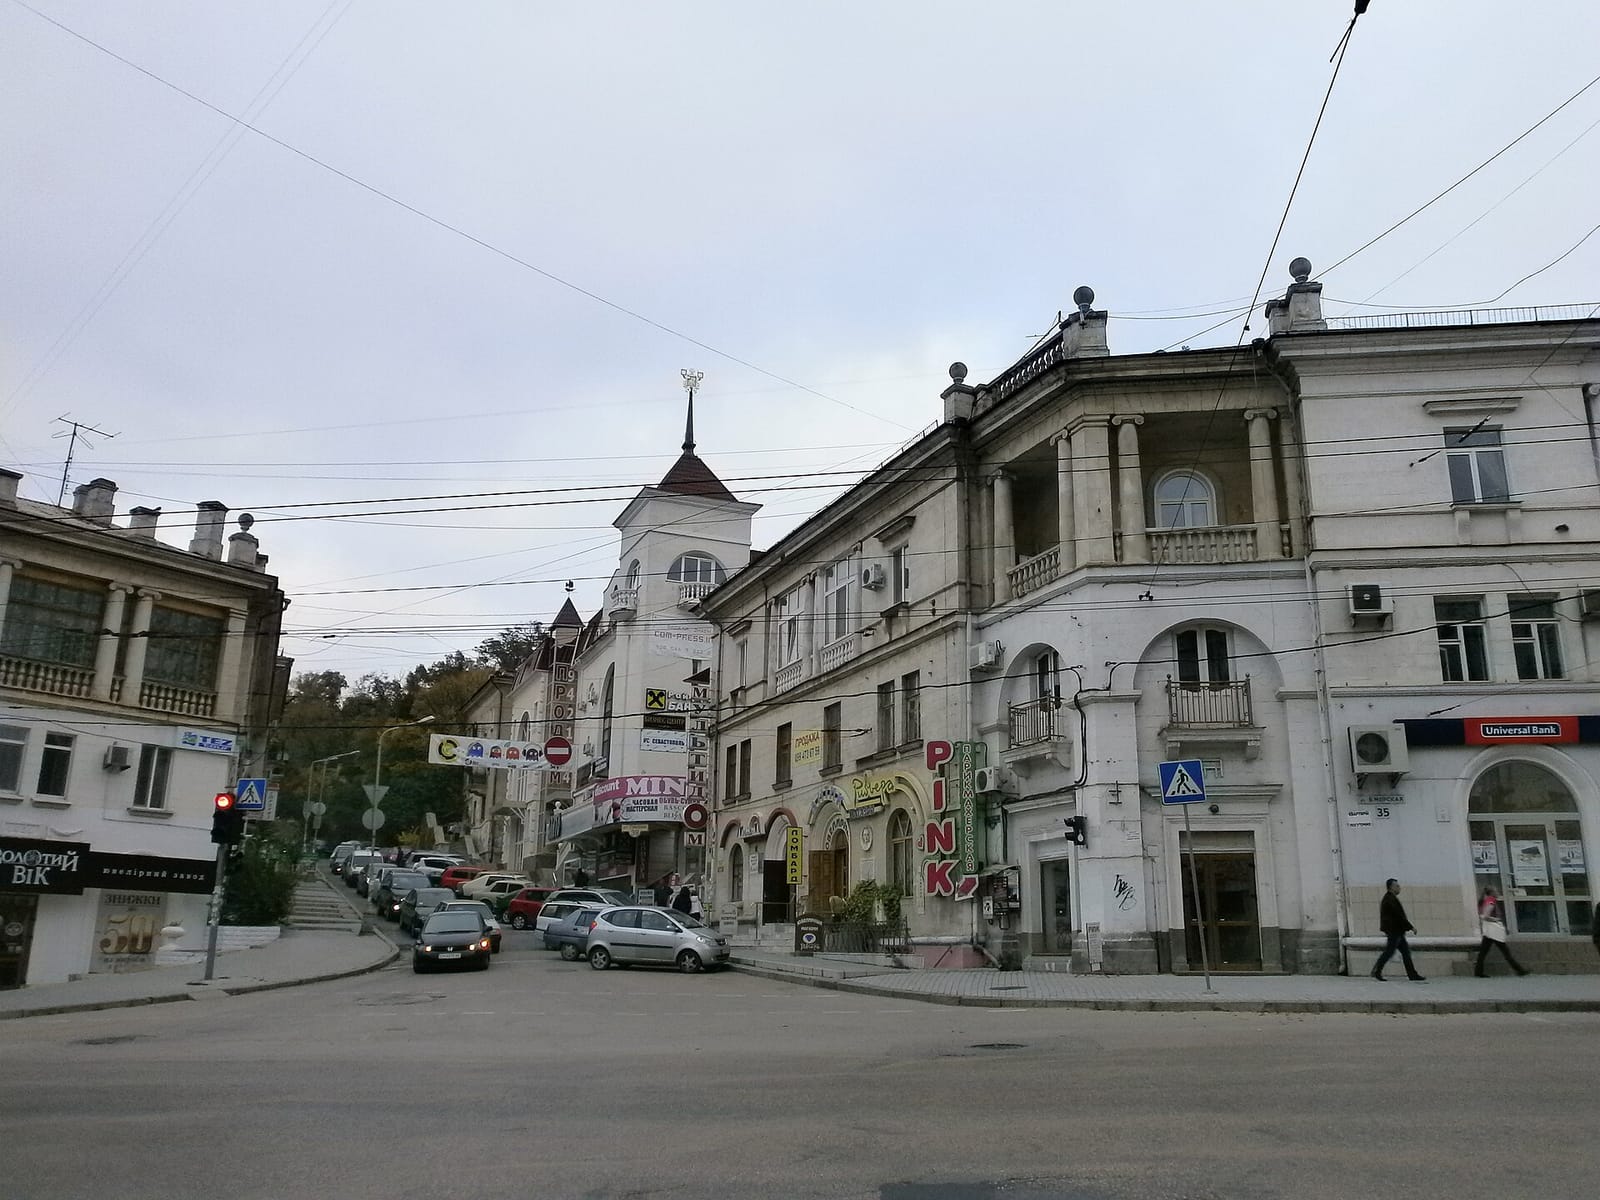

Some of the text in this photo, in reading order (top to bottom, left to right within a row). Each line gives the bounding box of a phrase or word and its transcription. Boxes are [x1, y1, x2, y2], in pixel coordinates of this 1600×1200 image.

[1485, 726, 1556, 735] Universal Bank
[200, 736, 233, 746] TEZ
[626, 805, 658, 813] МАСТЕРСКАЯ
[962, 743, 975, 872] ПАРИКМАХЕРСКАЯ
[1377, 808, 1390, 817] 35
[926, 741, 955, 896] PINK
[0, 849, 79, 872] ОЛОТИЙ
[11, 865, 51, 885] ВІК
[173, 873, 205, 881] завод
[104, 894, 161, 905] ЗНИЖКИ
[100, 914, 154, 955] 50
